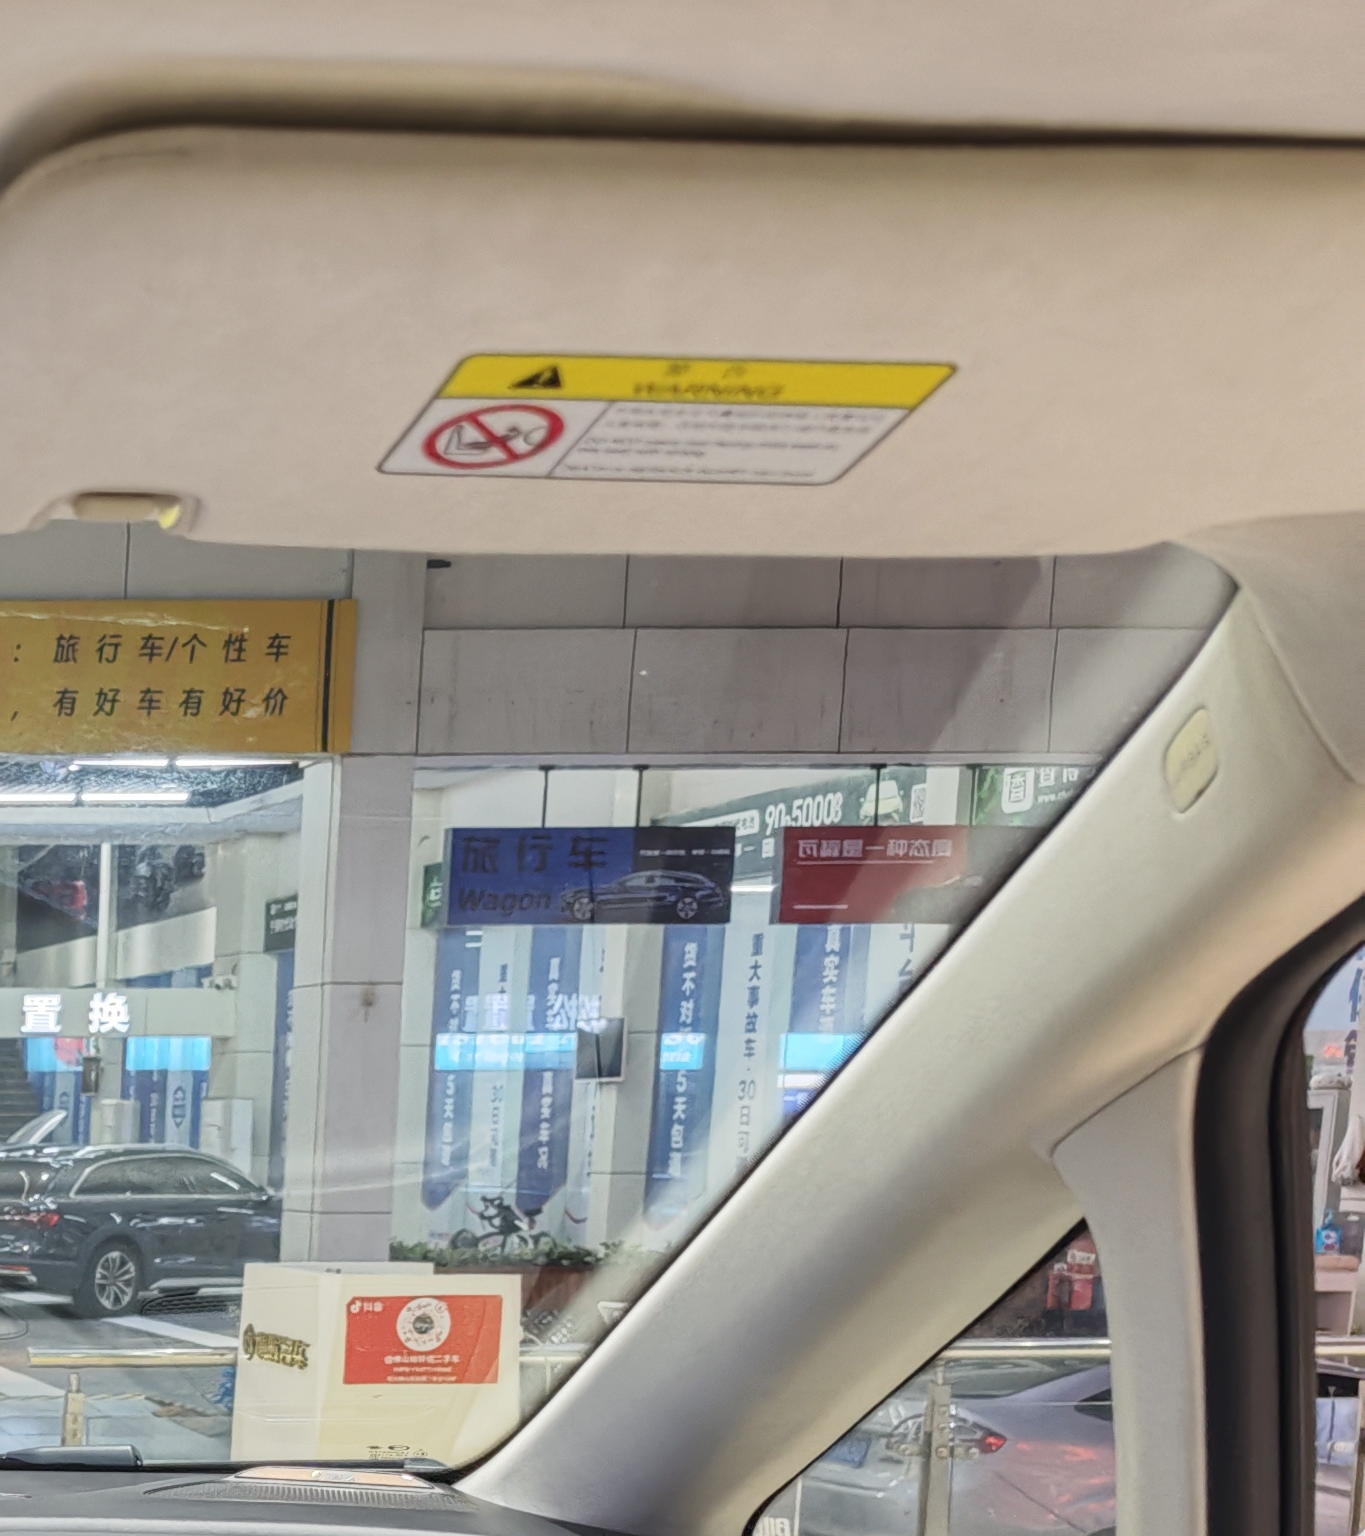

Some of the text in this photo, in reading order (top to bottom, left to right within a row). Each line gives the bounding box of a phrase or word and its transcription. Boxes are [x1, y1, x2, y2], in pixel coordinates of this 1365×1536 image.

[460, 834, 610, 874] 旅行车
[456, 887, 553, 917] Wagon
